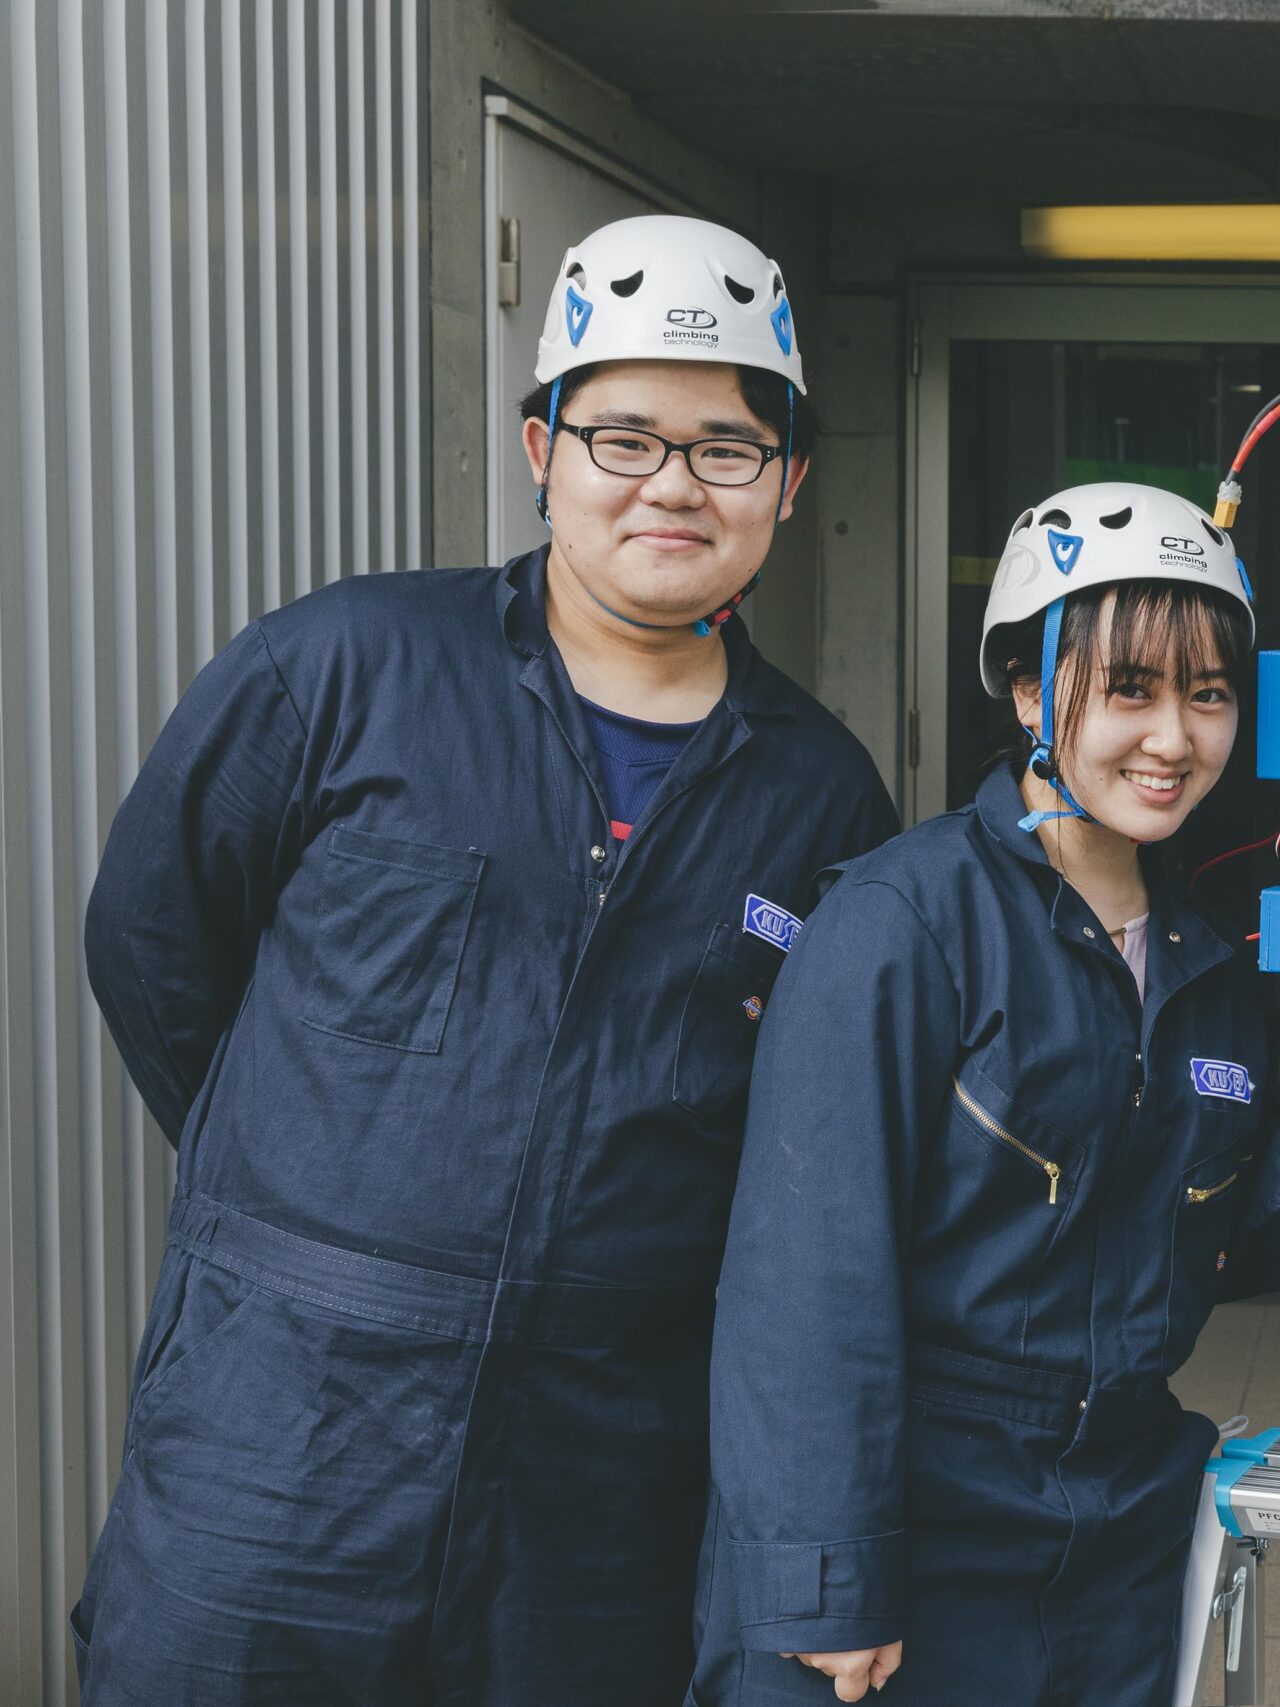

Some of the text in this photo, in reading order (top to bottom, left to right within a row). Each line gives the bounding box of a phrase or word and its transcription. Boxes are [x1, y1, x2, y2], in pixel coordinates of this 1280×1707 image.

[666, 308, 706, 324] CT
[663, 330, 719, 342] climbing
[664, 339, 719, 348] technology
[1160, 536, 1196, 550] CT
[1159, 553, 1208, 569] climbing
[1160, 560, 1208, 573] technology
